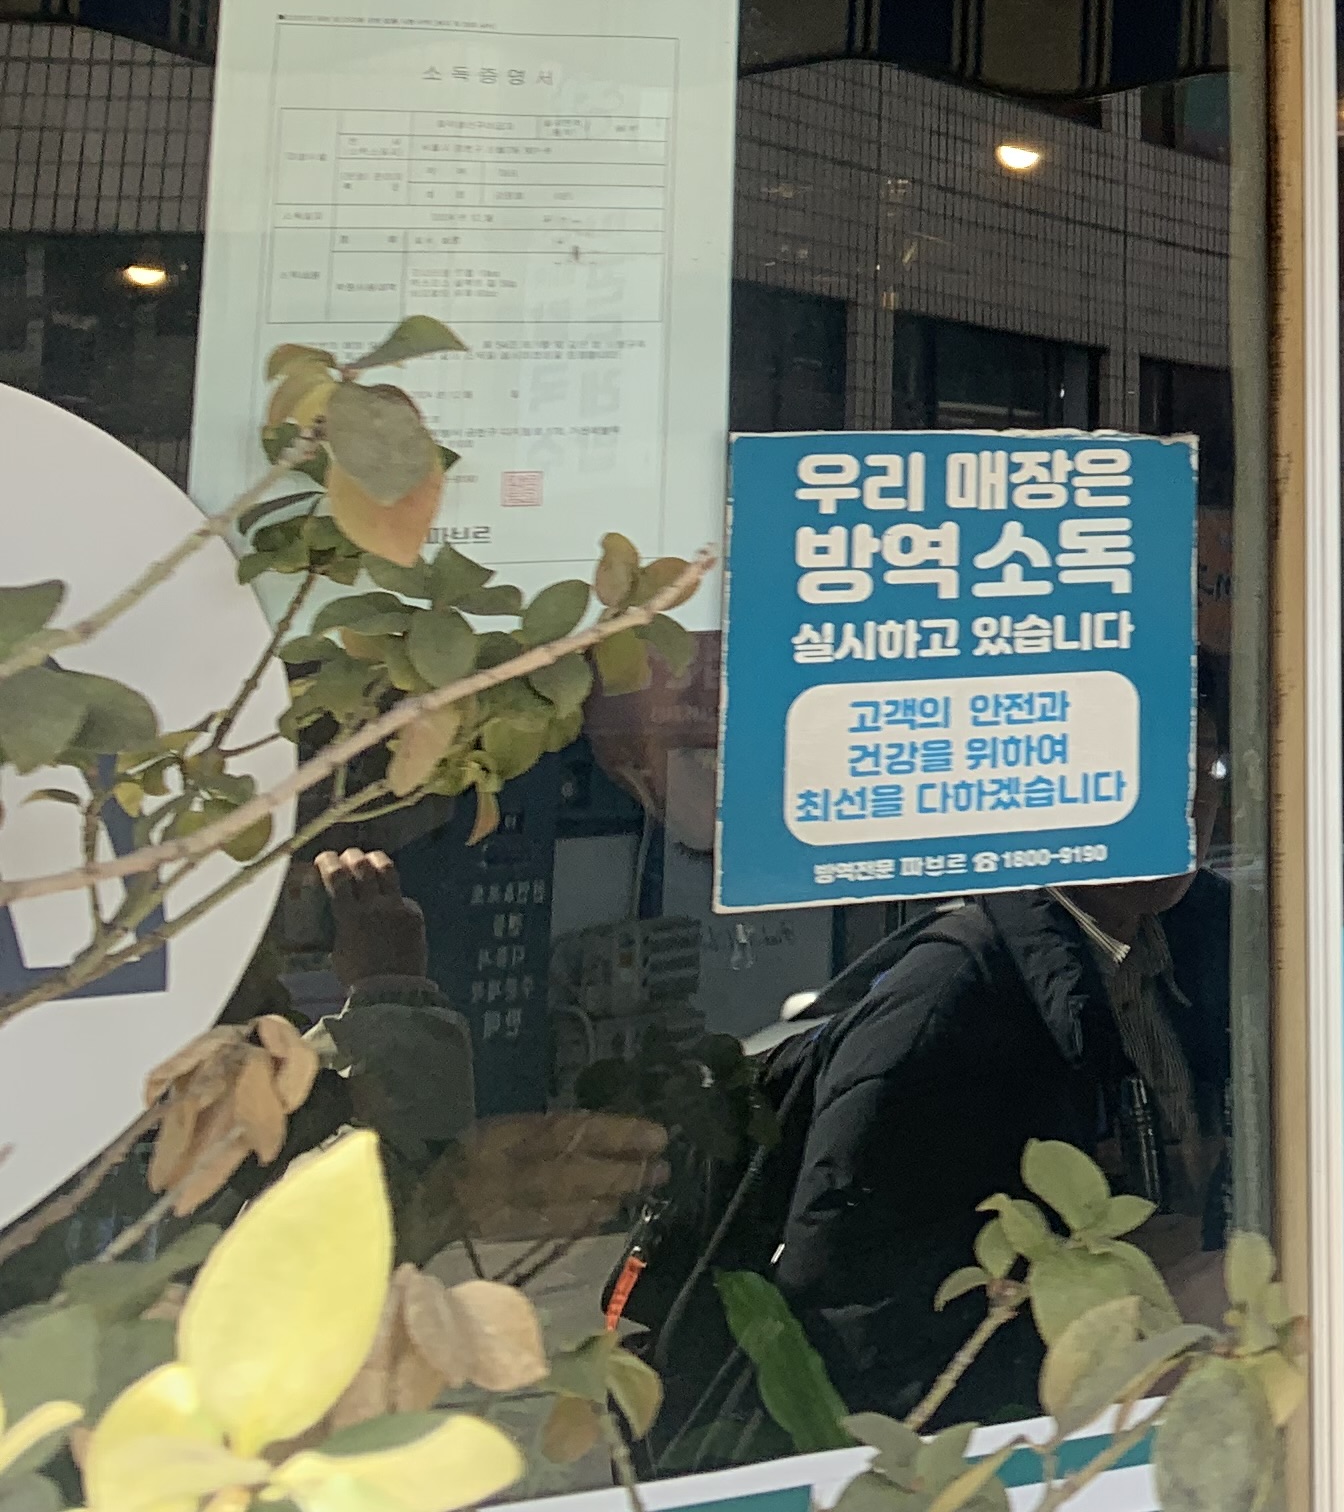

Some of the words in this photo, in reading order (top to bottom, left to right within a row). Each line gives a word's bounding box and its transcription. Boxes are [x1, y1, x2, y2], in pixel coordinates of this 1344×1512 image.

[795, 451, 926, 515] 우리
[945, 447, 1134, 511] 매장은
[794, 521, 960, 605] 방역
[970, 517, 1136, 599] 소독
[791, 618, 961, 665] 실시하고
[970, 610, 1136, 657] 있습니다
[848, 695, 951, 733] 고객의
[969, 690, 1071, 727] 안전과
[848, 738, 953, 778] 건강을
[965, 732, 1069, 771] 위하여
[795, 783, 905, 822] 최선을
[915, 770, 1127, 815] 다하겠습니다
[1000, 843, 1109, 869] 1800-9190
